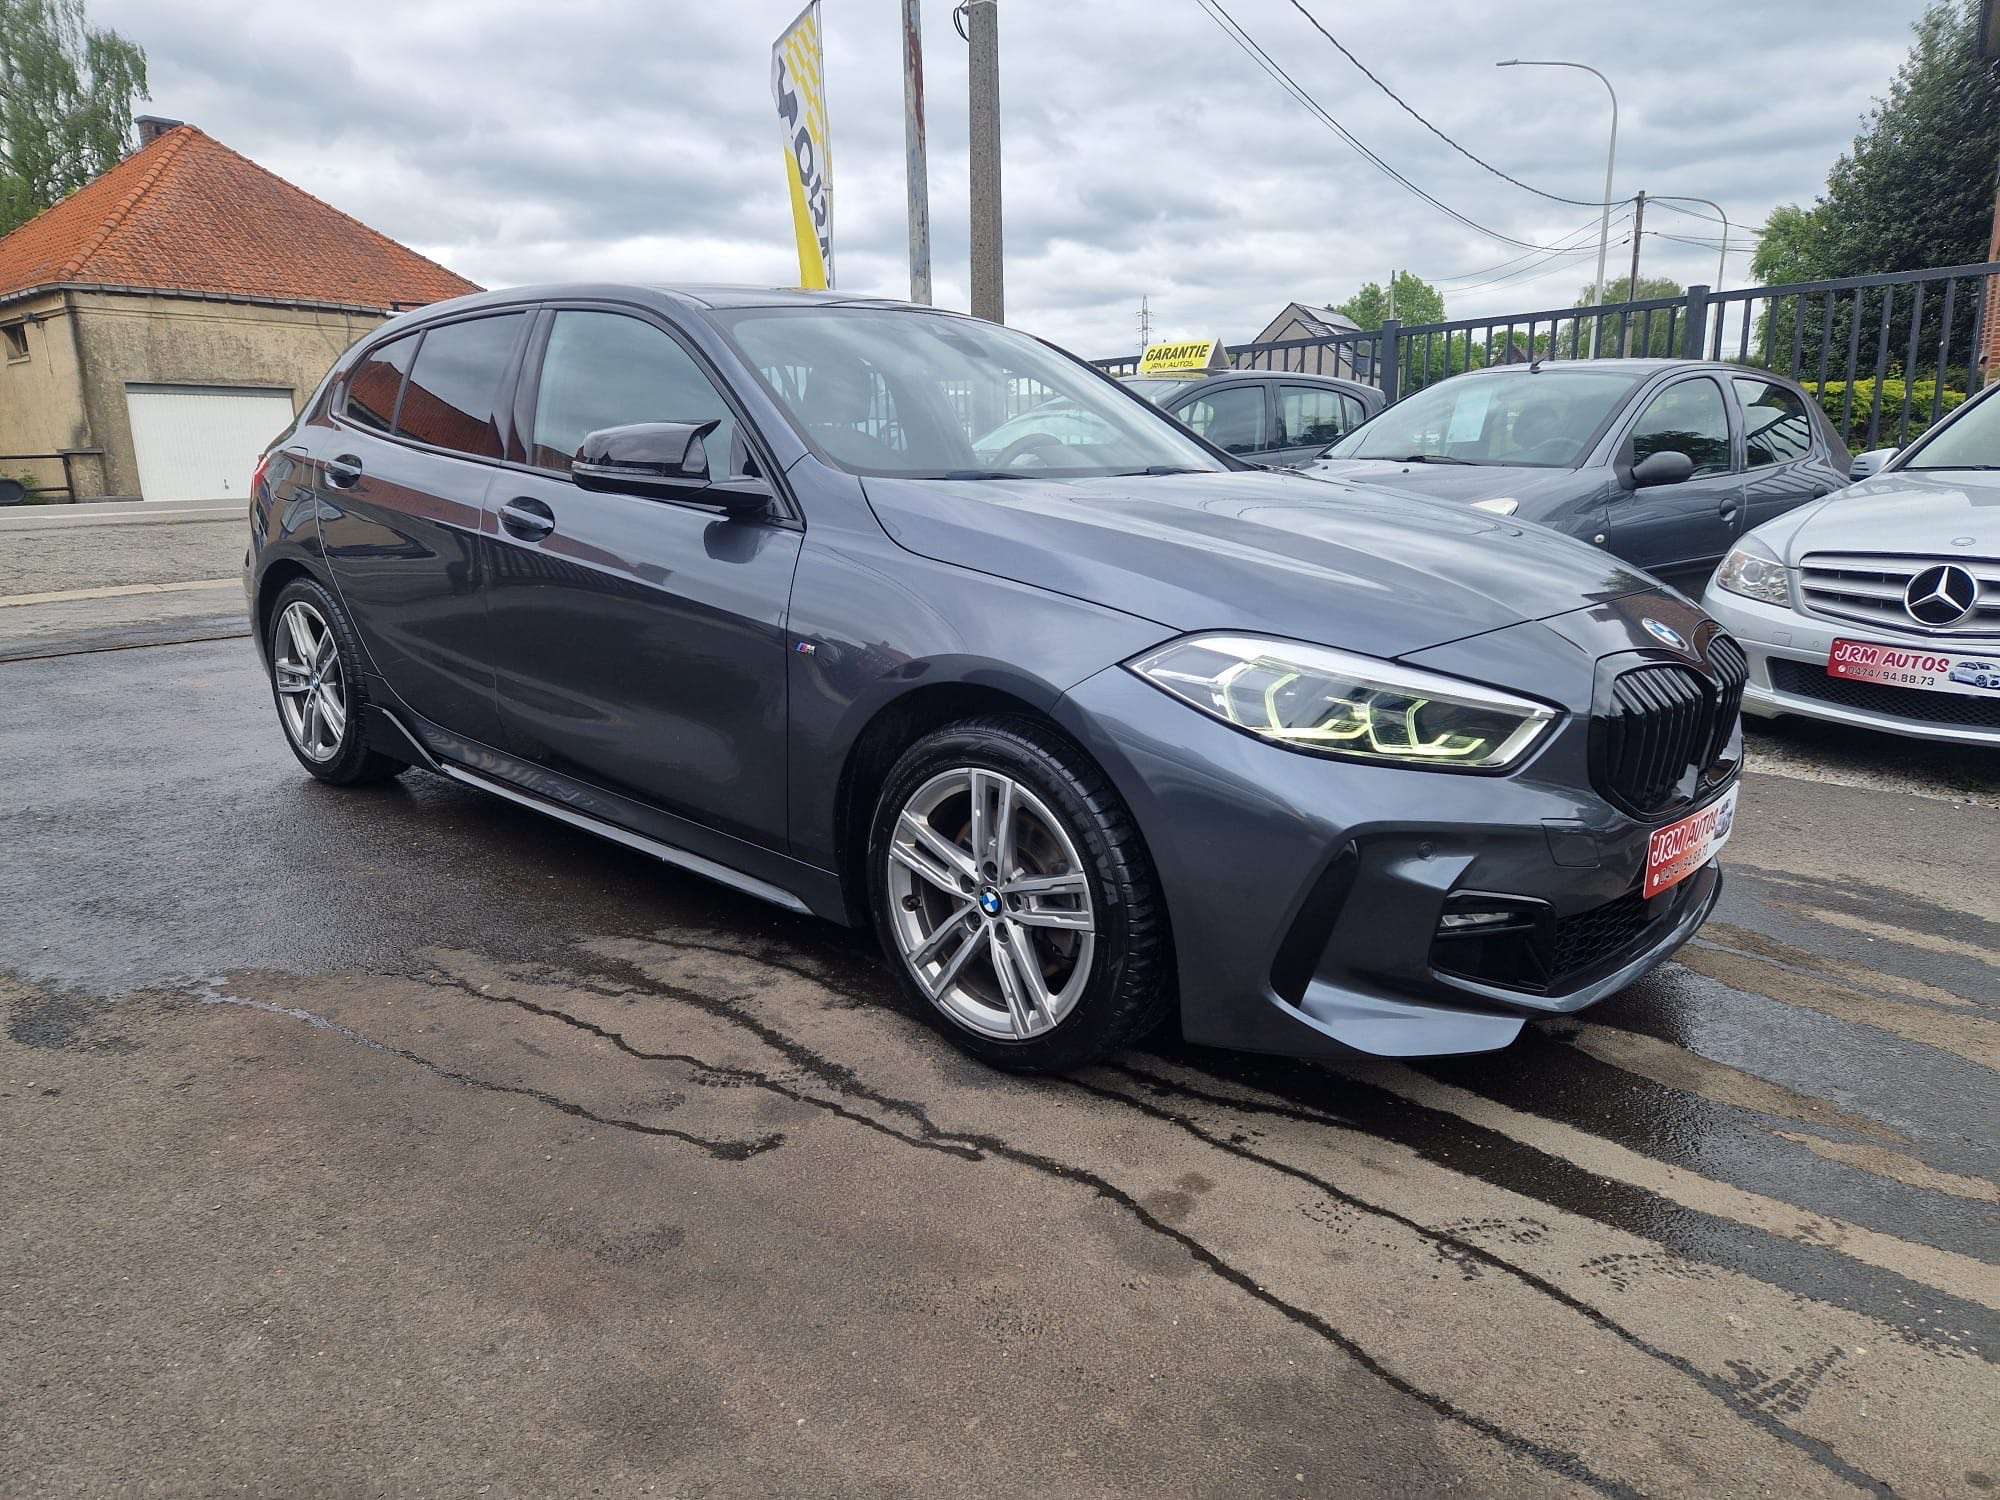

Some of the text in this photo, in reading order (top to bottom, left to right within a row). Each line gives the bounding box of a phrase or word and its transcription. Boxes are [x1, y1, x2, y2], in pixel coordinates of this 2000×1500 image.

[1145, 344, 1209, 361] GARANTIE
[1167, 360, 1194, 368] AUTOS
[1834, 644, 1950, 673] JRM AUTOS
[1652, 825, 1686, 866] JRM
[1685, 808, 1719, 850] AUTOS
